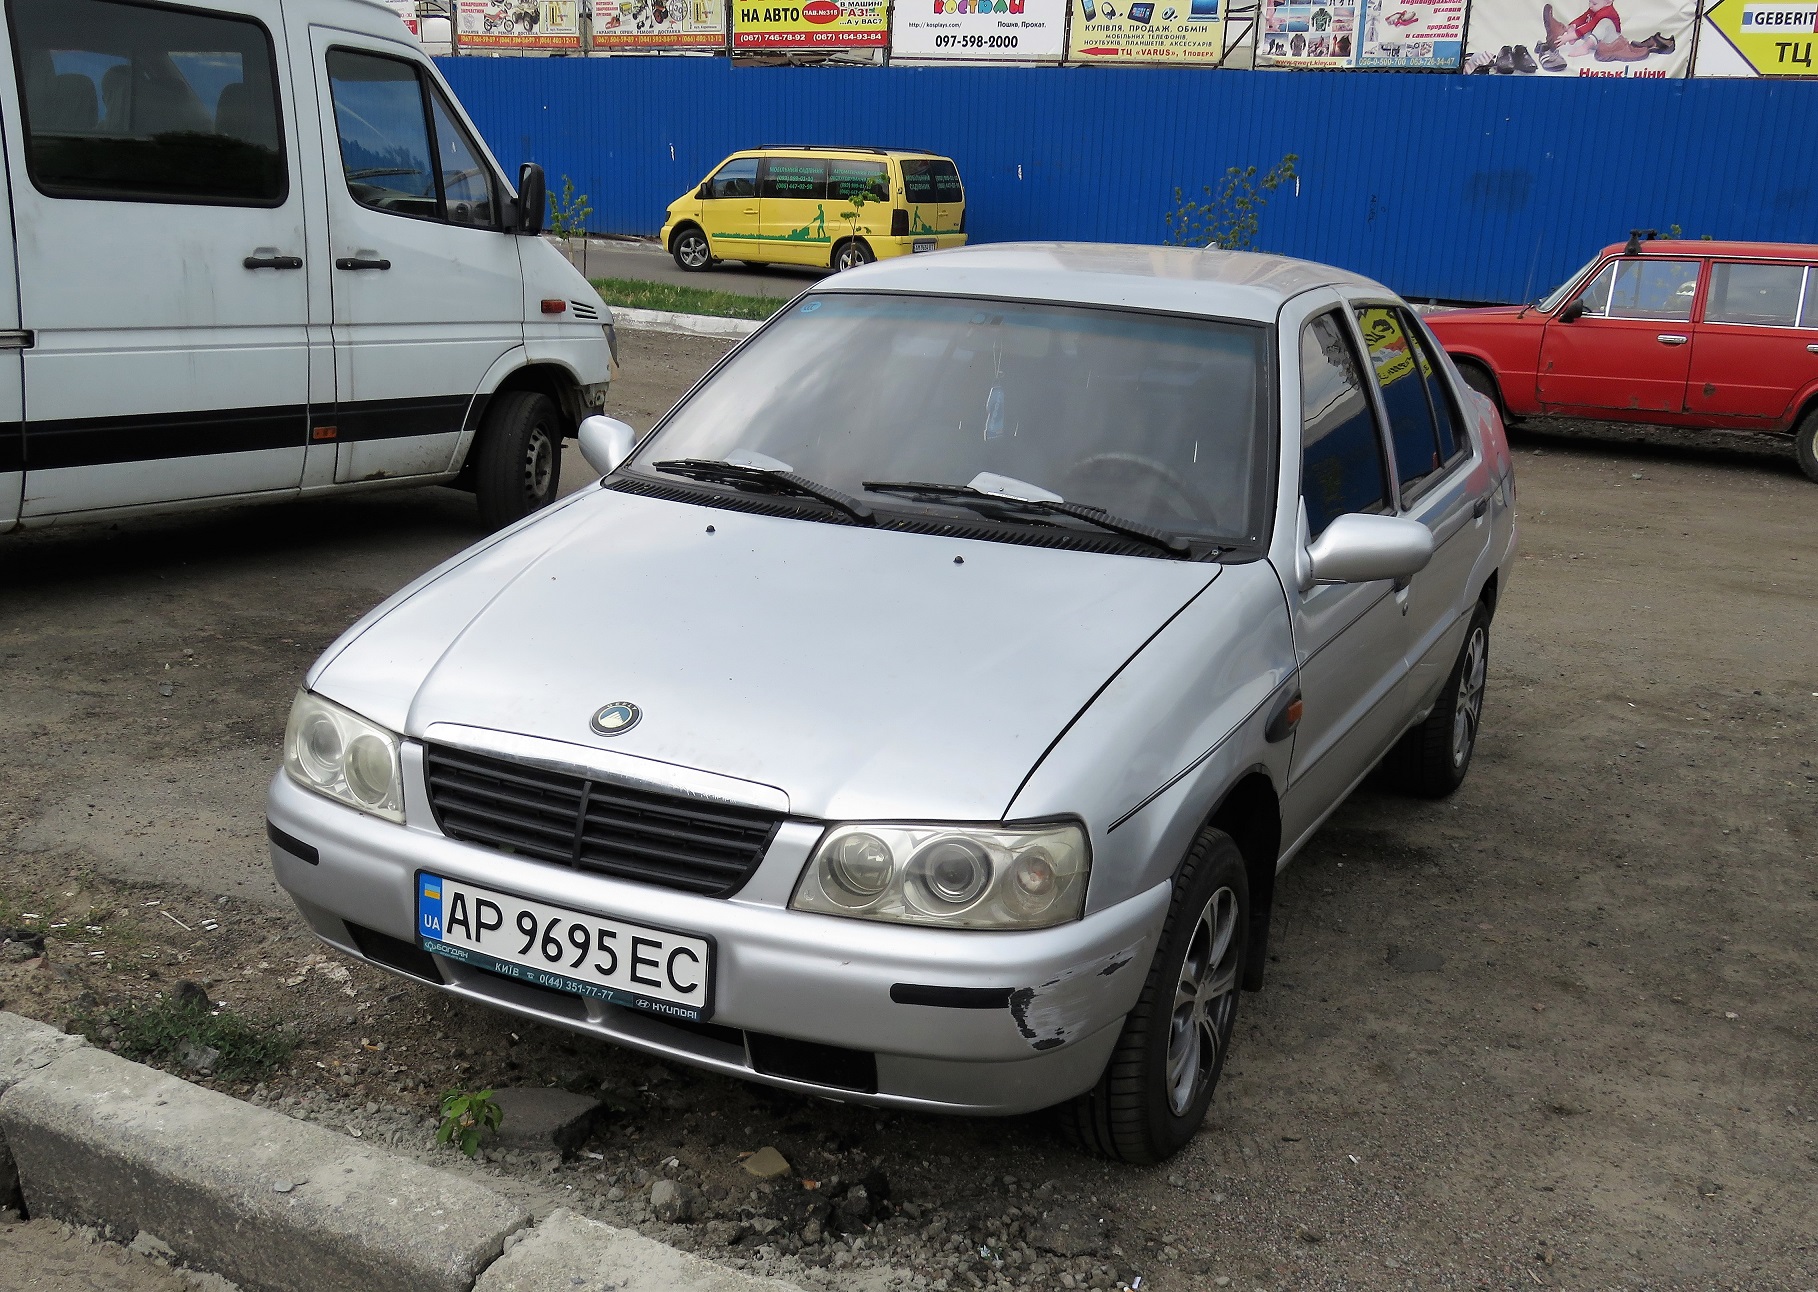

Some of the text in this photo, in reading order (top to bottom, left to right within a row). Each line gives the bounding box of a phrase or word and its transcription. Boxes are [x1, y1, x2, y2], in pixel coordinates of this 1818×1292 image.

[742, 8, 799, 22] НА АВТО
[1755, 12, 1817, 25] GEBERIT
[1021, 21, 1047, 29] Прокат.
[740, 34, 762, 42] (067)
[813, 34, 835, 42] (067)
[936, 35, 1019, 48] 097-598-2000
[1121, 49, 1132, 57] ТЦ
[1775, 42, 1812, 67] ТЦ
[1633, 67, 1666, 78] ціни
[424, 914, 440, 931] UA
[446, 892, 700, 997] AP 9695 EC
[495, 963, 520, 976] КИЇВ
[539, 974, 564, 990] 0(44)
[565, 981, 615, 1000] 351-77-77
[652, 1003, 698, 1019] HYUNDAI
